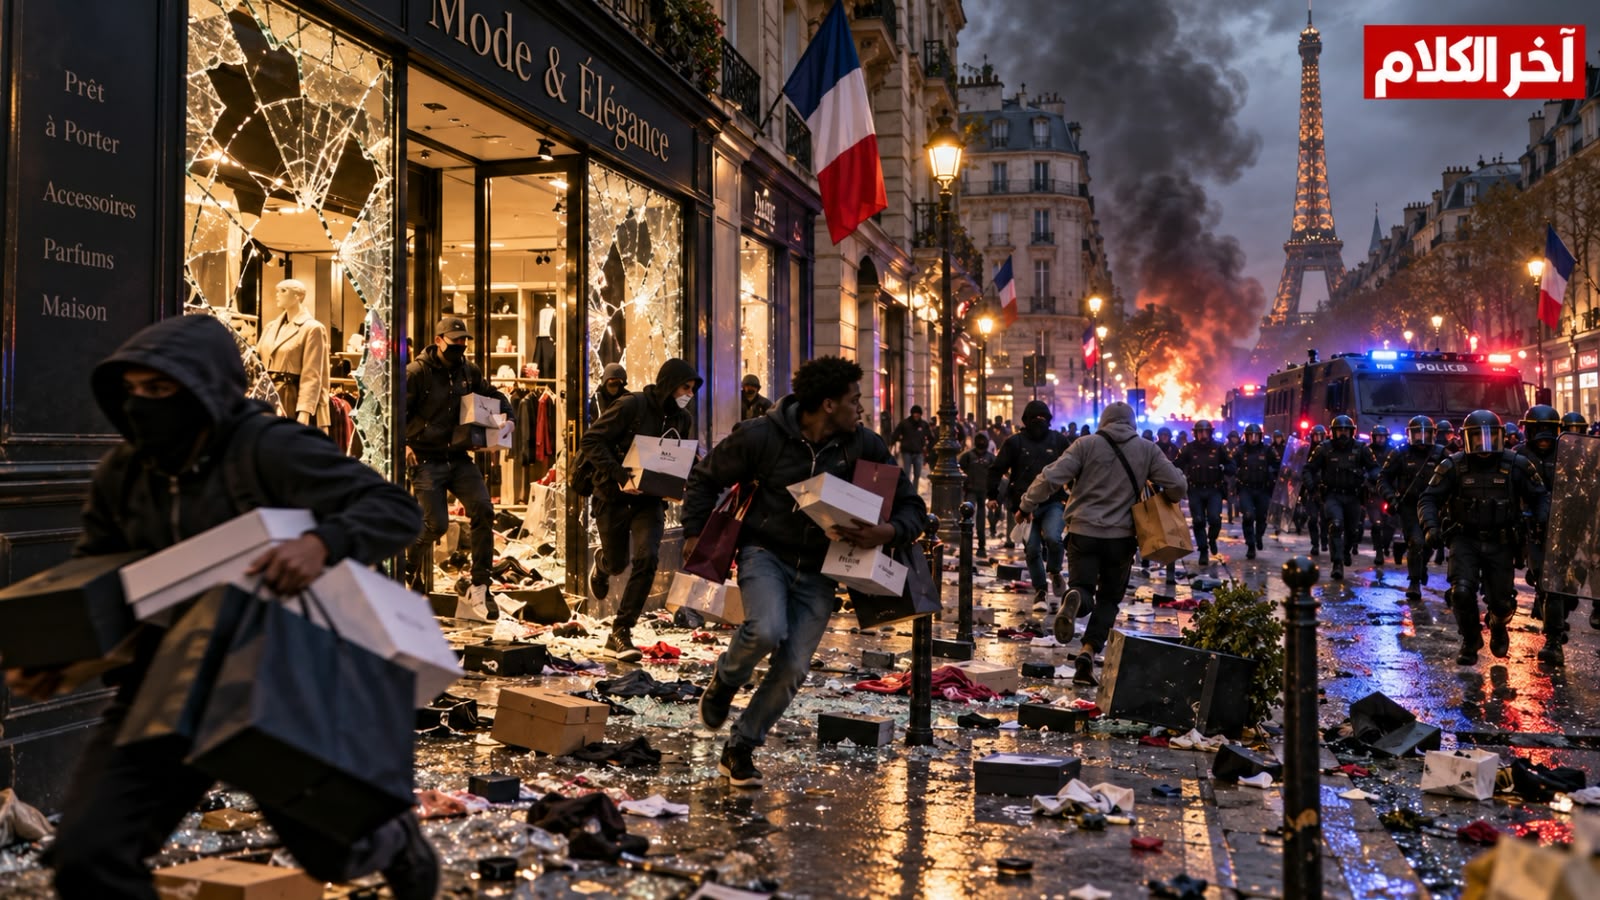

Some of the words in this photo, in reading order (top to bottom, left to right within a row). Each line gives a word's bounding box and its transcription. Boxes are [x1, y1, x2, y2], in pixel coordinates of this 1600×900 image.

[64, 69, 105, 103] Prêt
[428, 0, 532, 82] Mode
[545, 46, 568, 104] &
[578, 56, 669, 162] Élégance
[45, 114, 57, 138] à
[64, 119, 120, 154] Porter
[42, 180, 137, 219] Accessoires
[43, 237, 115, 270] Parfums
[41, 294, 108, 322] Maison
